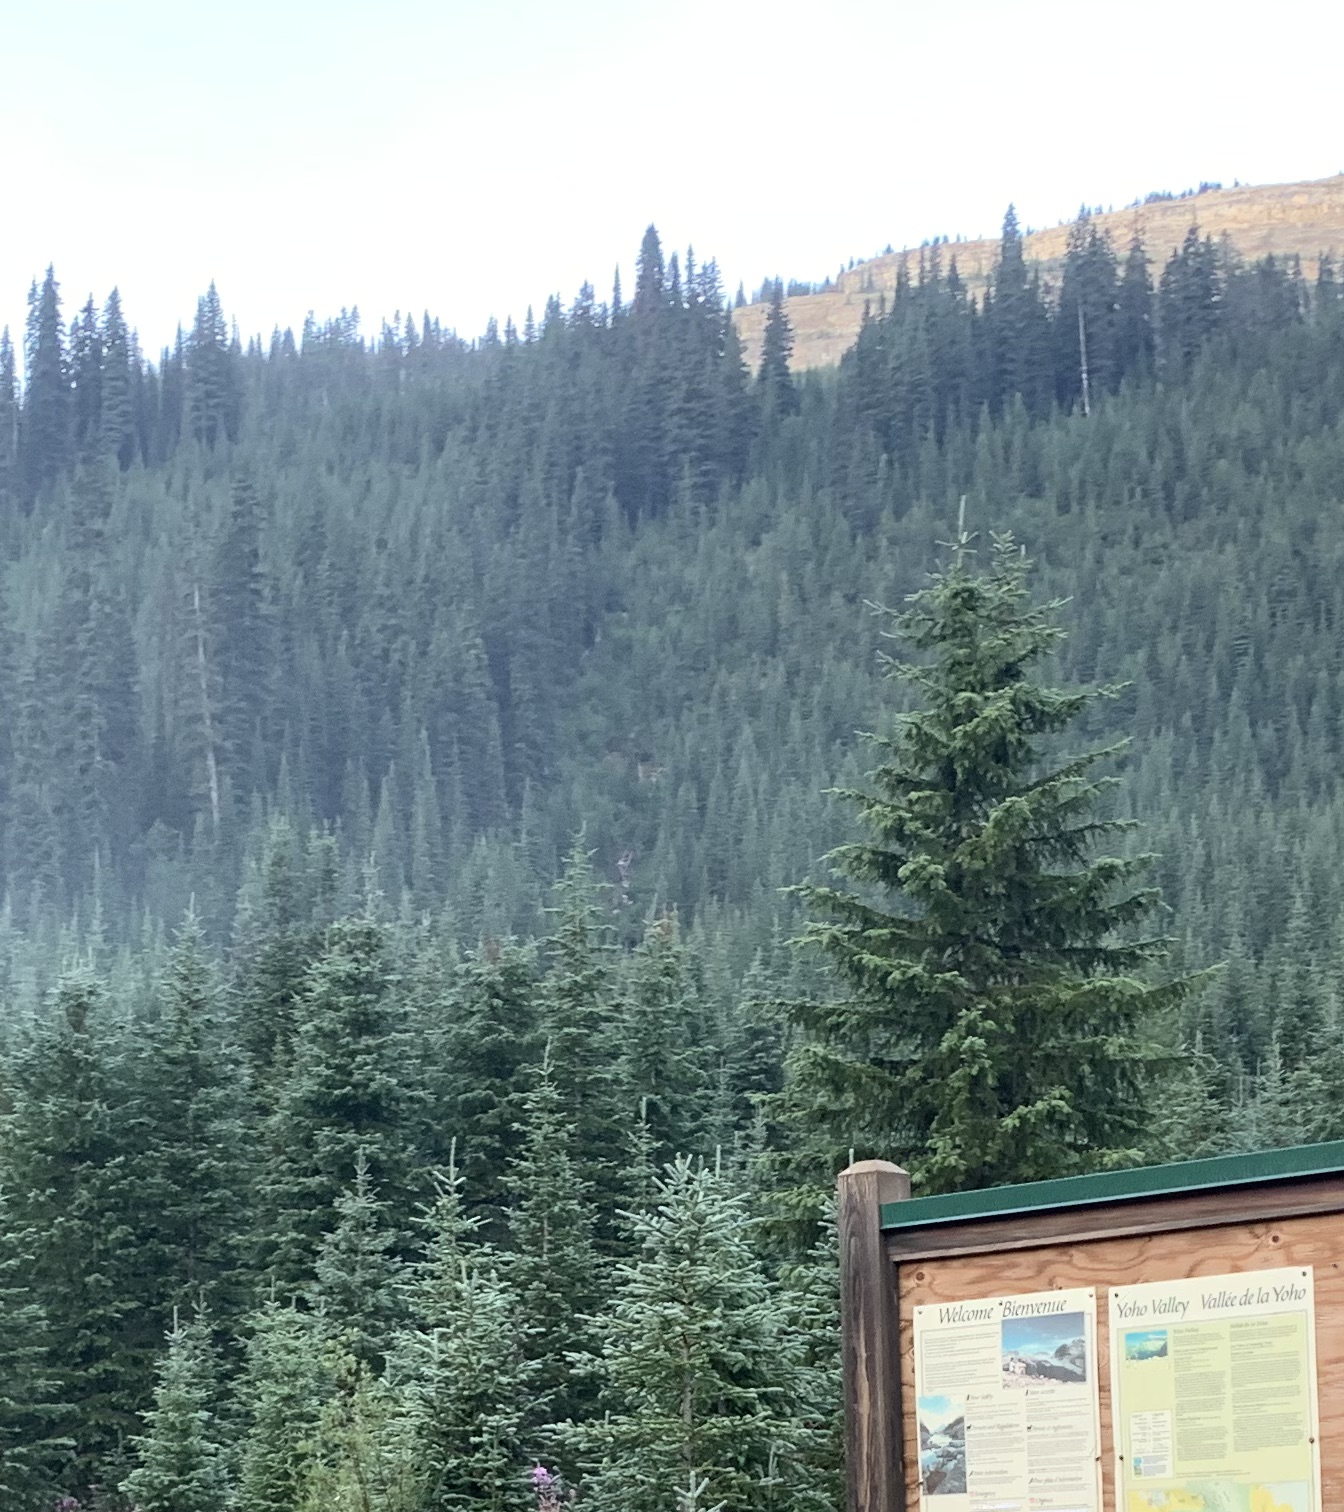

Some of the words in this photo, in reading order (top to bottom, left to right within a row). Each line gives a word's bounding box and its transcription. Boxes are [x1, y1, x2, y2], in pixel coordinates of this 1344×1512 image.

[1201, 1290, 1237, 1310] Vallée
[1239, 1288, 1254, 1307] de
[1256, 1287, 1269, 1304] la
[1272, 1284, 1306, 1303] Yoho
[939, 1306, 993, 1324] Welcome
[1002, 1300, 1067, 1318] Bienvenue
[1117, 1300, 1147, 1318] Yoho
[1152, 1296, 1189, 1319] Valley
